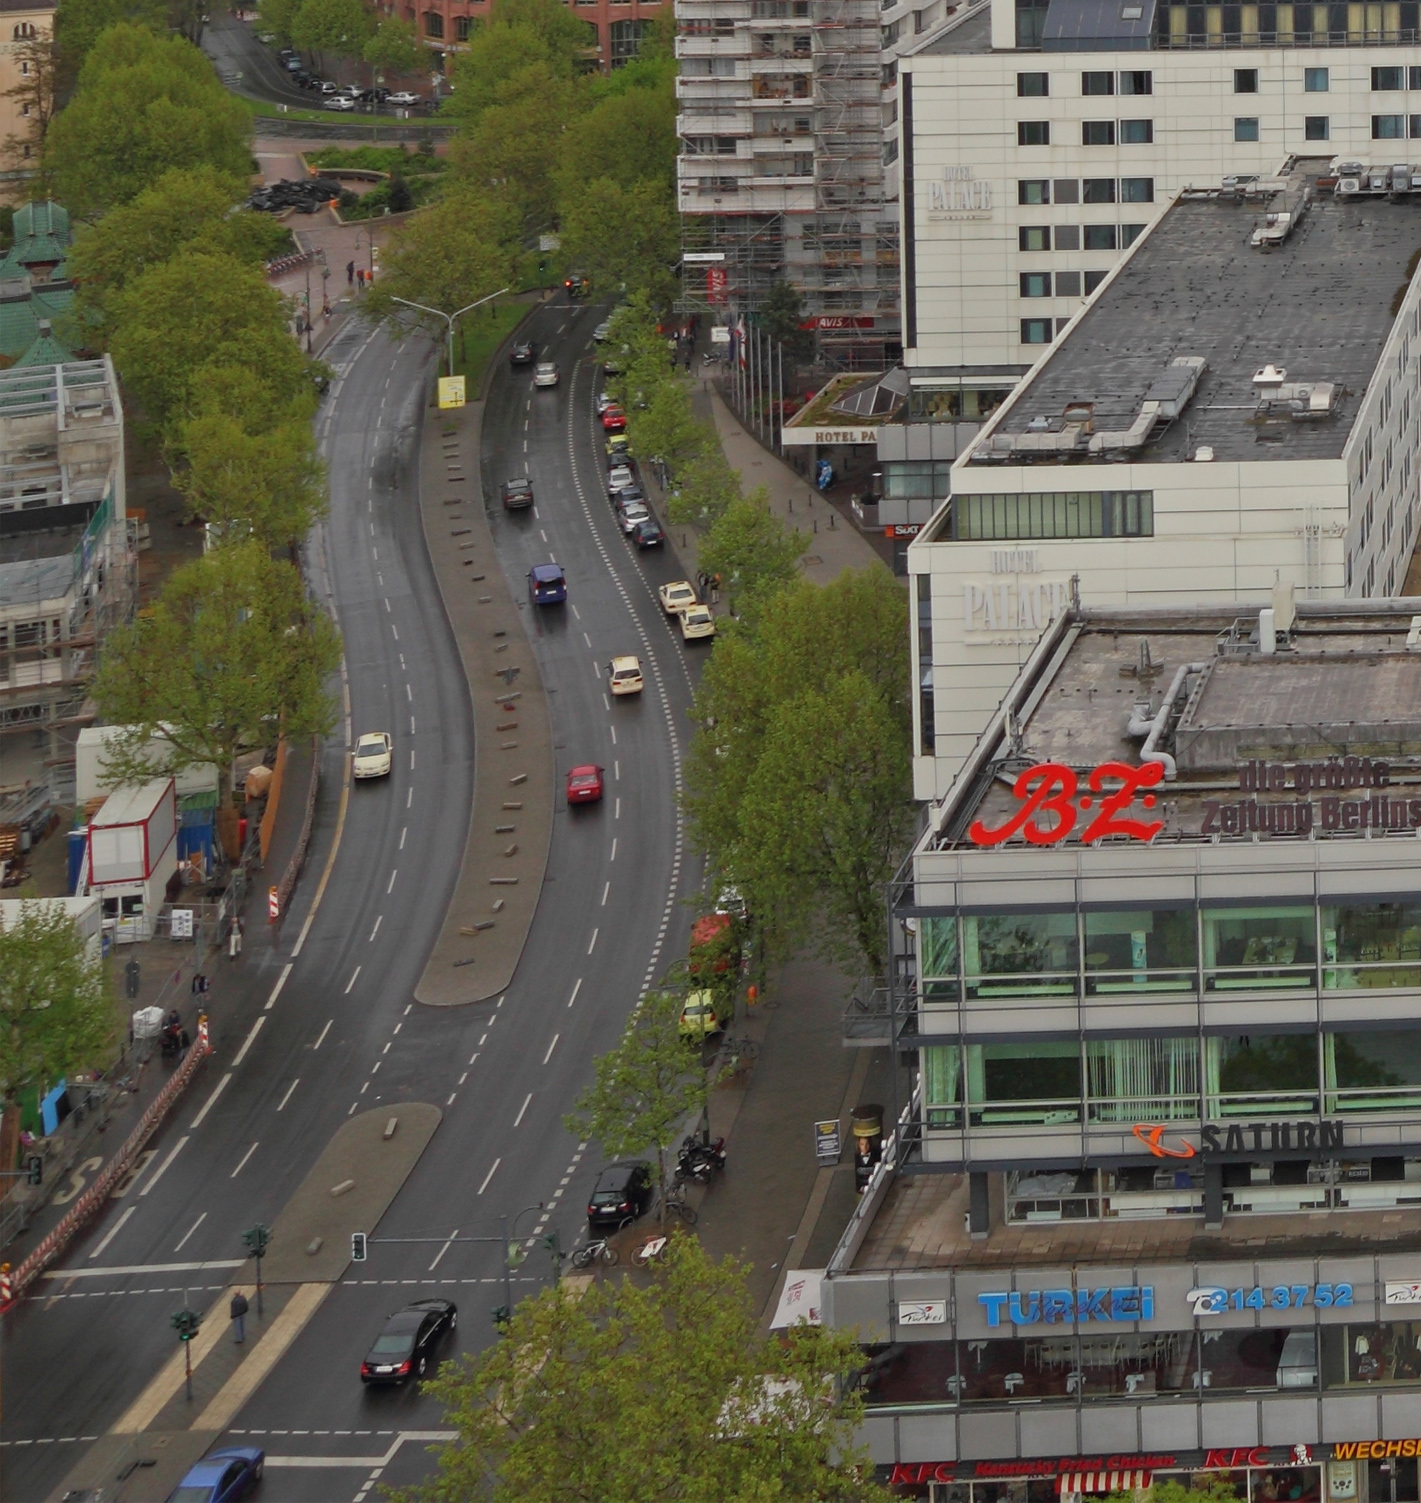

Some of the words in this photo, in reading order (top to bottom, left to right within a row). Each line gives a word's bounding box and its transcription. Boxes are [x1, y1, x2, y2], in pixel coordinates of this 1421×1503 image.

[926, 182, 993, 211] PALACE
[819, 317, 844, 328] AVIS
[815, 431, 857, 442] HOTEL
[1238, 759, 1286, 793] die
[1294, 754, 1390, 796] größte
[1200, 798, 1313, 837] Zeitung
[1200, 1118, 1344, 1155] SATURN
[891, 1461, 959, 1485] KFC
[974, 1458, 1057, 1477] Kentucky
[1059, 1455, 1104, 1474] Fried
[1107, 1453, 1178, 1469] Chicken
[1204, 1445, 1272, 1467] KFC
